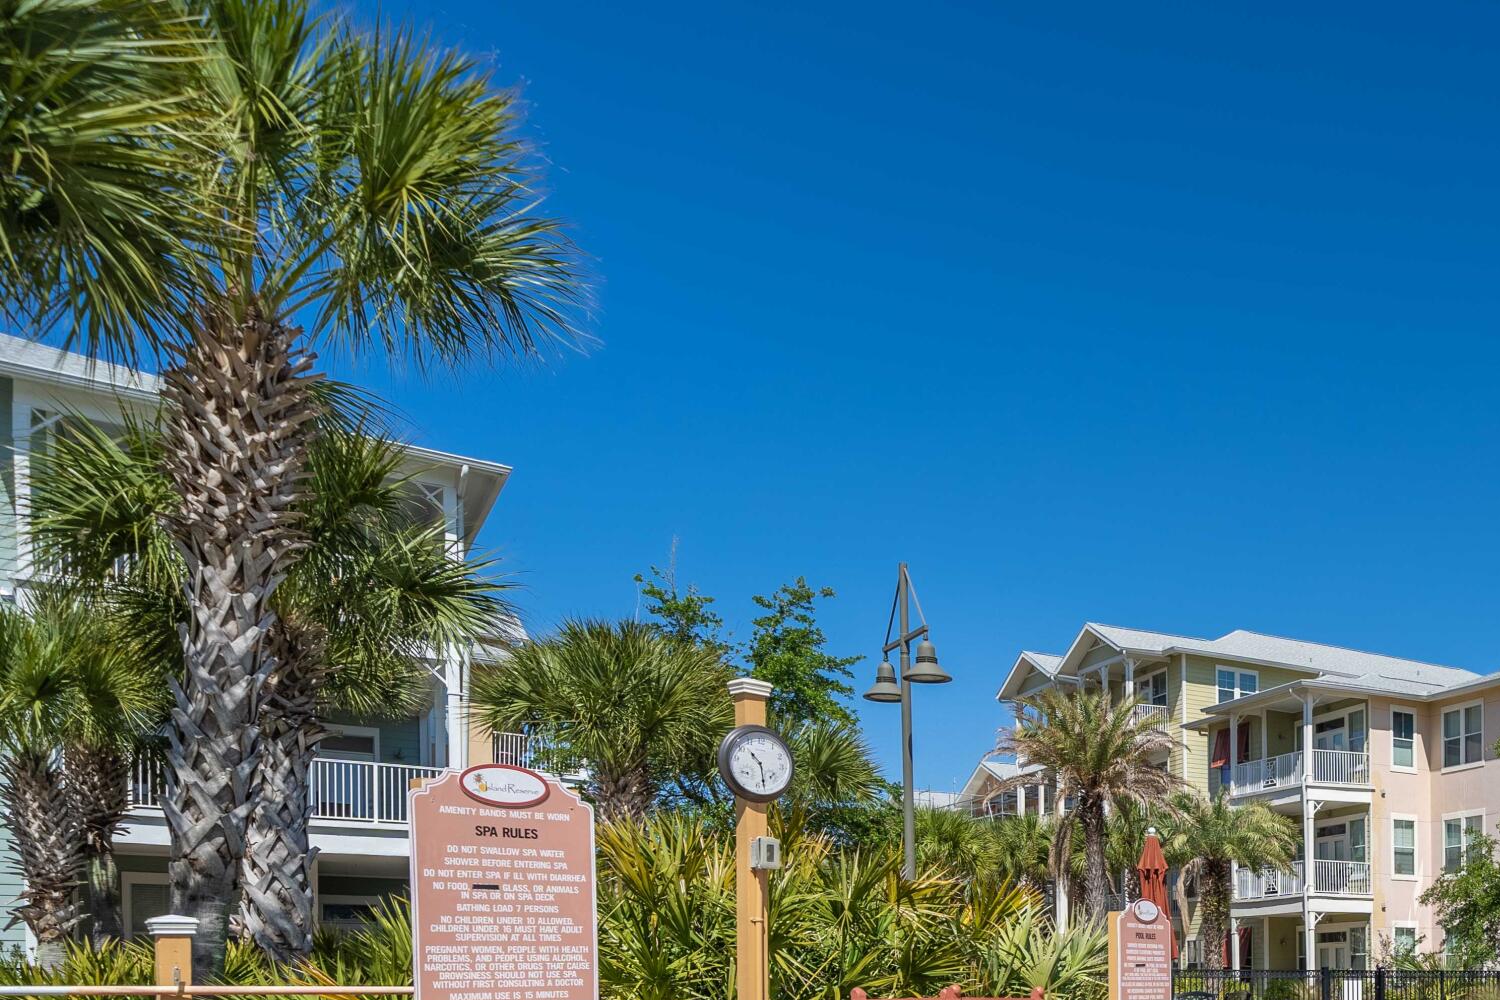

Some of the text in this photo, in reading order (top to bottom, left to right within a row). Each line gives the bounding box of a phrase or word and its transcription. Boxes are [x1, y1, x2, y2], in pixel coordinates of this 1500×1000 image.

[439, 805, 570, 822] AMENITY BANDS MUST BE WORN
[475, 825, 538, 839] SPA RULES
[447, 845, 565, 858] DO NOT SWALLOW SPA WATER
[444, 857, 568, 870] SHOWER BEFORE ENTERING SPA
[423, 868, 586, 882] DO NOT ENTER SPA IF ILL WITH DIARRHEA
[432, 882, 445, 890] NO
[533, 885, 544, 893] OR
[546, 885, 580, 894] ANIMALS
[461, 891, 469, 899] IN
[490, 892, 501, 900] OR
[518, 893, 533, 901] SPA
[535, 893, 555, 901] DECK
[456, 903, 490, 912] BATHING
[493, 904, 513, 912] LOAD
[524, 905, 559, 913] PERSONS
[440, 915, 452, 923] NO
[455, 915, 494, 924] CHILDREN
[497, 916, 523, 924] UNDER
[430, 924, 469, 933] CHILDREN
[472, 925, 499, 933] UNDER
[514, 925, 537, 933] MUST
[539, 925, 559, 933] HAVE
[455, 933, 508, 941] SUPERVISION
[425, 945, 469, 954] PREGNANT
[507, 945, 536, 953] PEOPLE
[539, 945, 559, 953] WITH
[561, 945, 589, 953] HEALTH
[475, 954, 492, 962] AND
[495, 954, 524, 962] PEOPLE
[527, 954, 550, 962] USING
[475, 963, 486, 971] OR
[489, 962, 515, 971] OTHER
[517, 962, 543, 970] DRUGS
[546, 962, 564, 970] THAT
[566, 962, 590, 970] CAUSE
[440, 971, 491, 980] DROWSINESS
[494, 971, 525, 979] SHOULD
[528, 971, 544, 979] NOT
[563, 970, 577, 978] SPA
[432, 980, 470, 989] WITHOUT
[473, 980, 495, 988] FIRST
[498, 979, 544, 988] CONSULTING
[555, 979, 584, 987] DOCTOR
[450, 992, 492, 1000] MAXIMUM
[495, 992, 510, 1000] USE
[525, 991, 533, 999] 15
[536, 991, 568, 999] MINUTES
